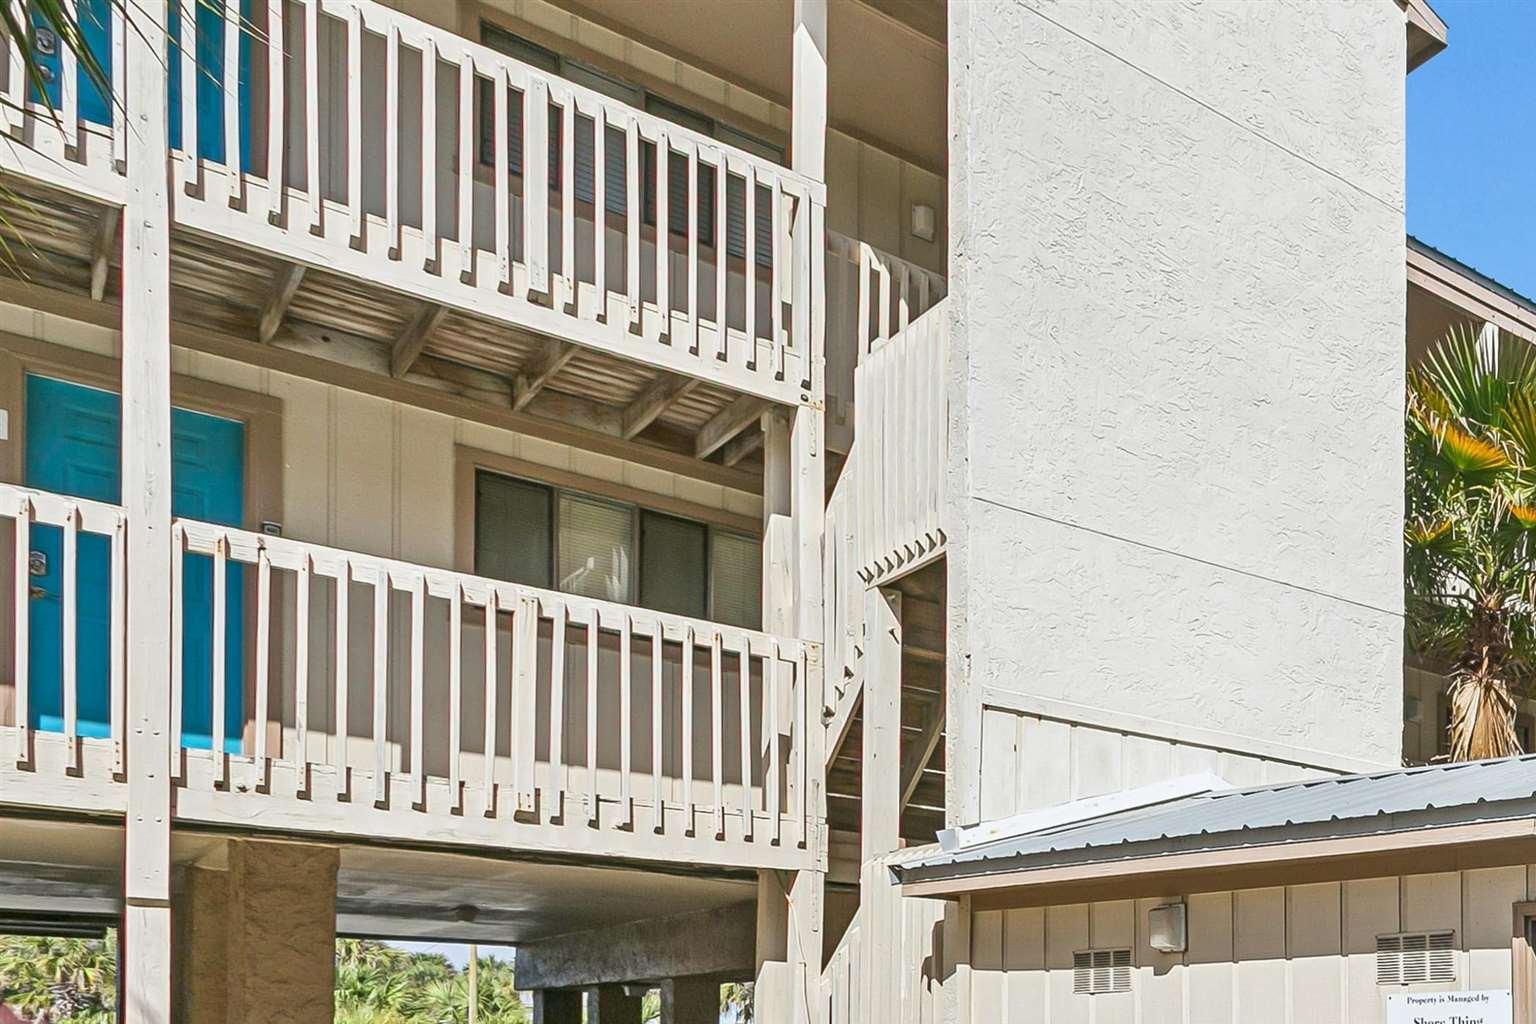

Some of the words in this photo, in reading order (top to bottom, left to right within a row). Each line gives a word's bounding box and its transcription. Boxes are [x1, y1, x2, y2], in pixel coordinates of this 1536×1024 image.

[1407, 996, 1436, 1005] Property
[1448, 994, 1480, 1004] Managed
[1481, 994, 1489, 1004] by
